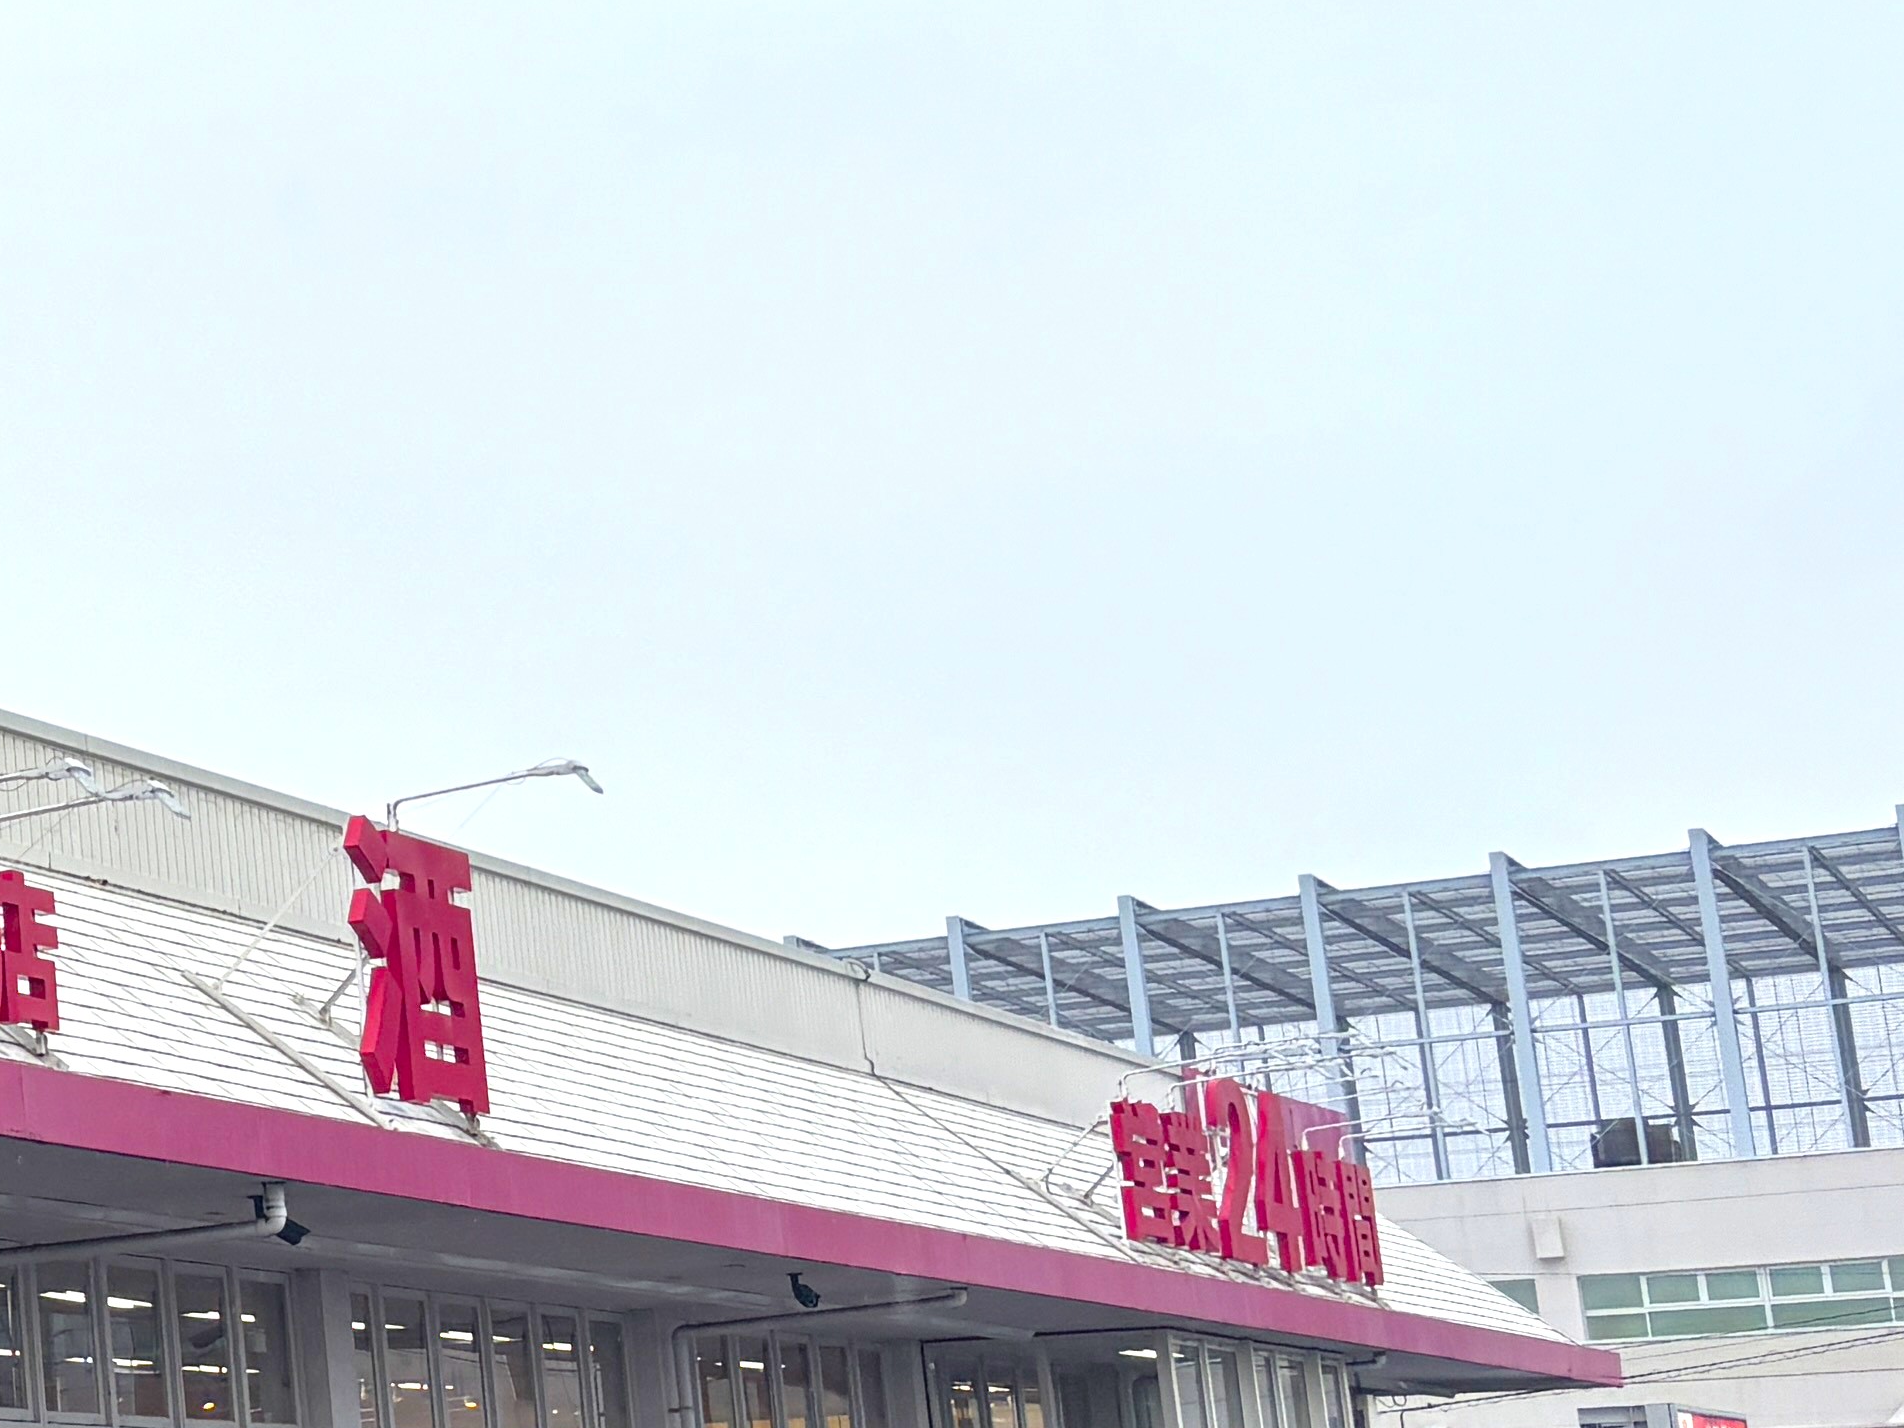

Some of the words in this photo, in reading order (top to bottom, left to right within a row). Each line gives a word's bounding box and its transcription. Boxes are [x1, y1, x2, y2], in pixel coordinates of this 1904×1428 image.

[342, 815, 490, 1115] 酒
[1109, 1077, 1384, 1286] 営業24時間
